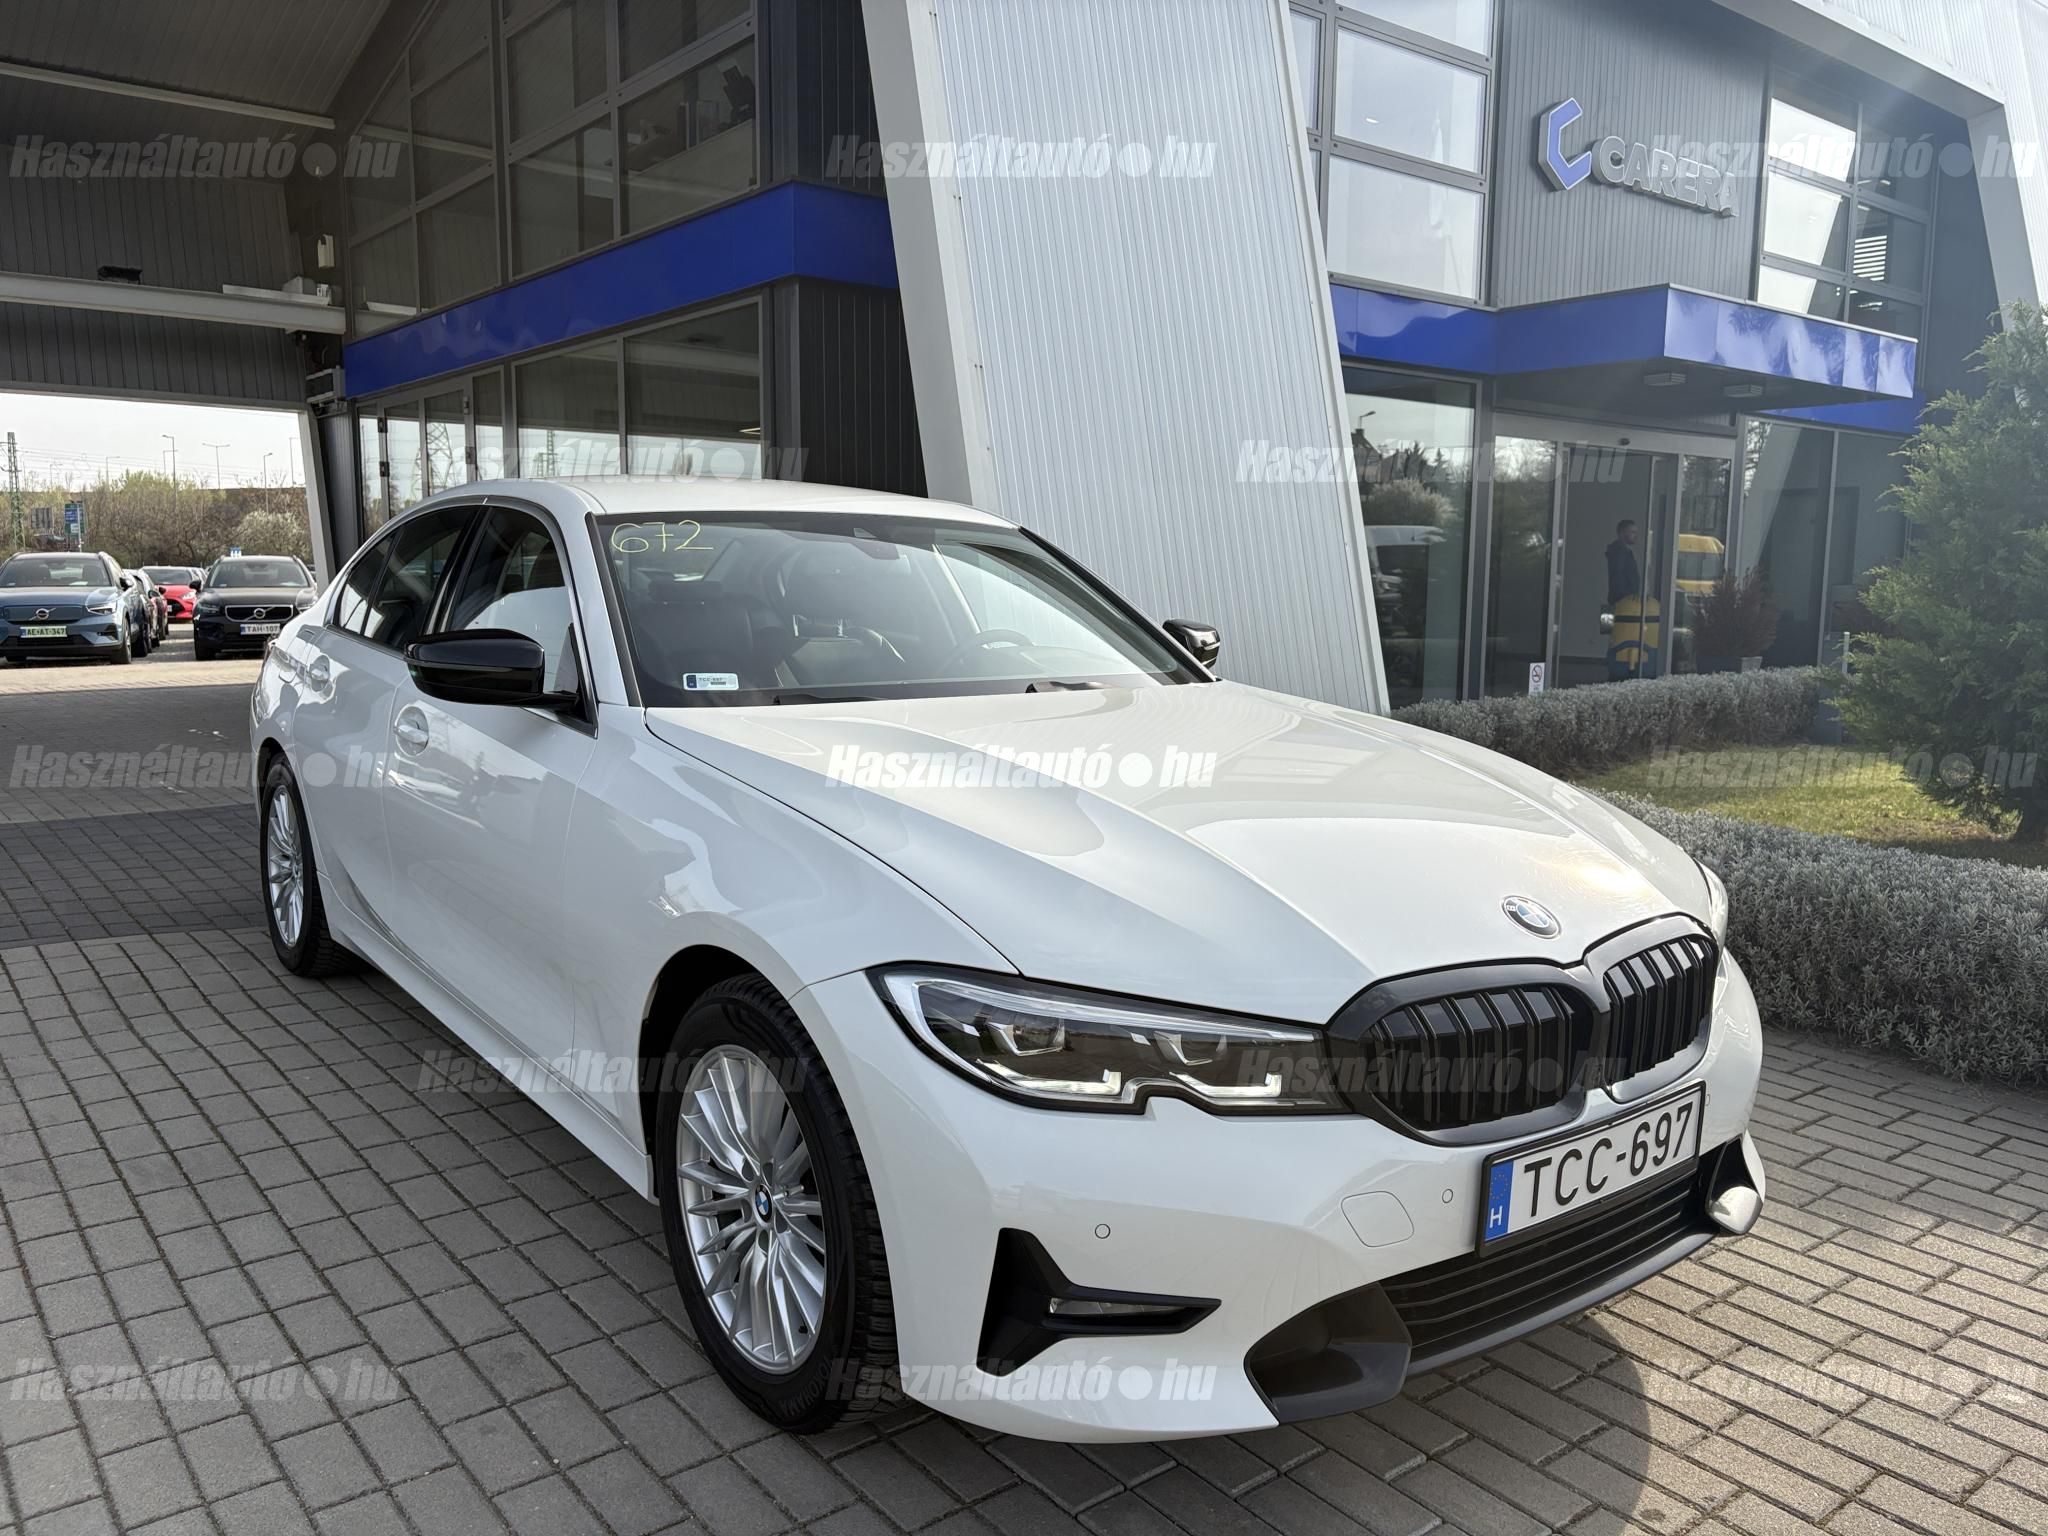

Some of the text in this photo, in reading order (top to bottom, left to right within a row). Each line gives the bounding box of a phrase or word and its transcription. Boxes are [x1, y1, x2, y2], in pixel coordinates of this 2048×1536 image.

[1599, 135, 1739, 217] CARERA
[611, 519, 714, 552] 672
[1524, 1101, 1693, 1218] TCC-697
[1489, 1205, 1503, 1229] H
